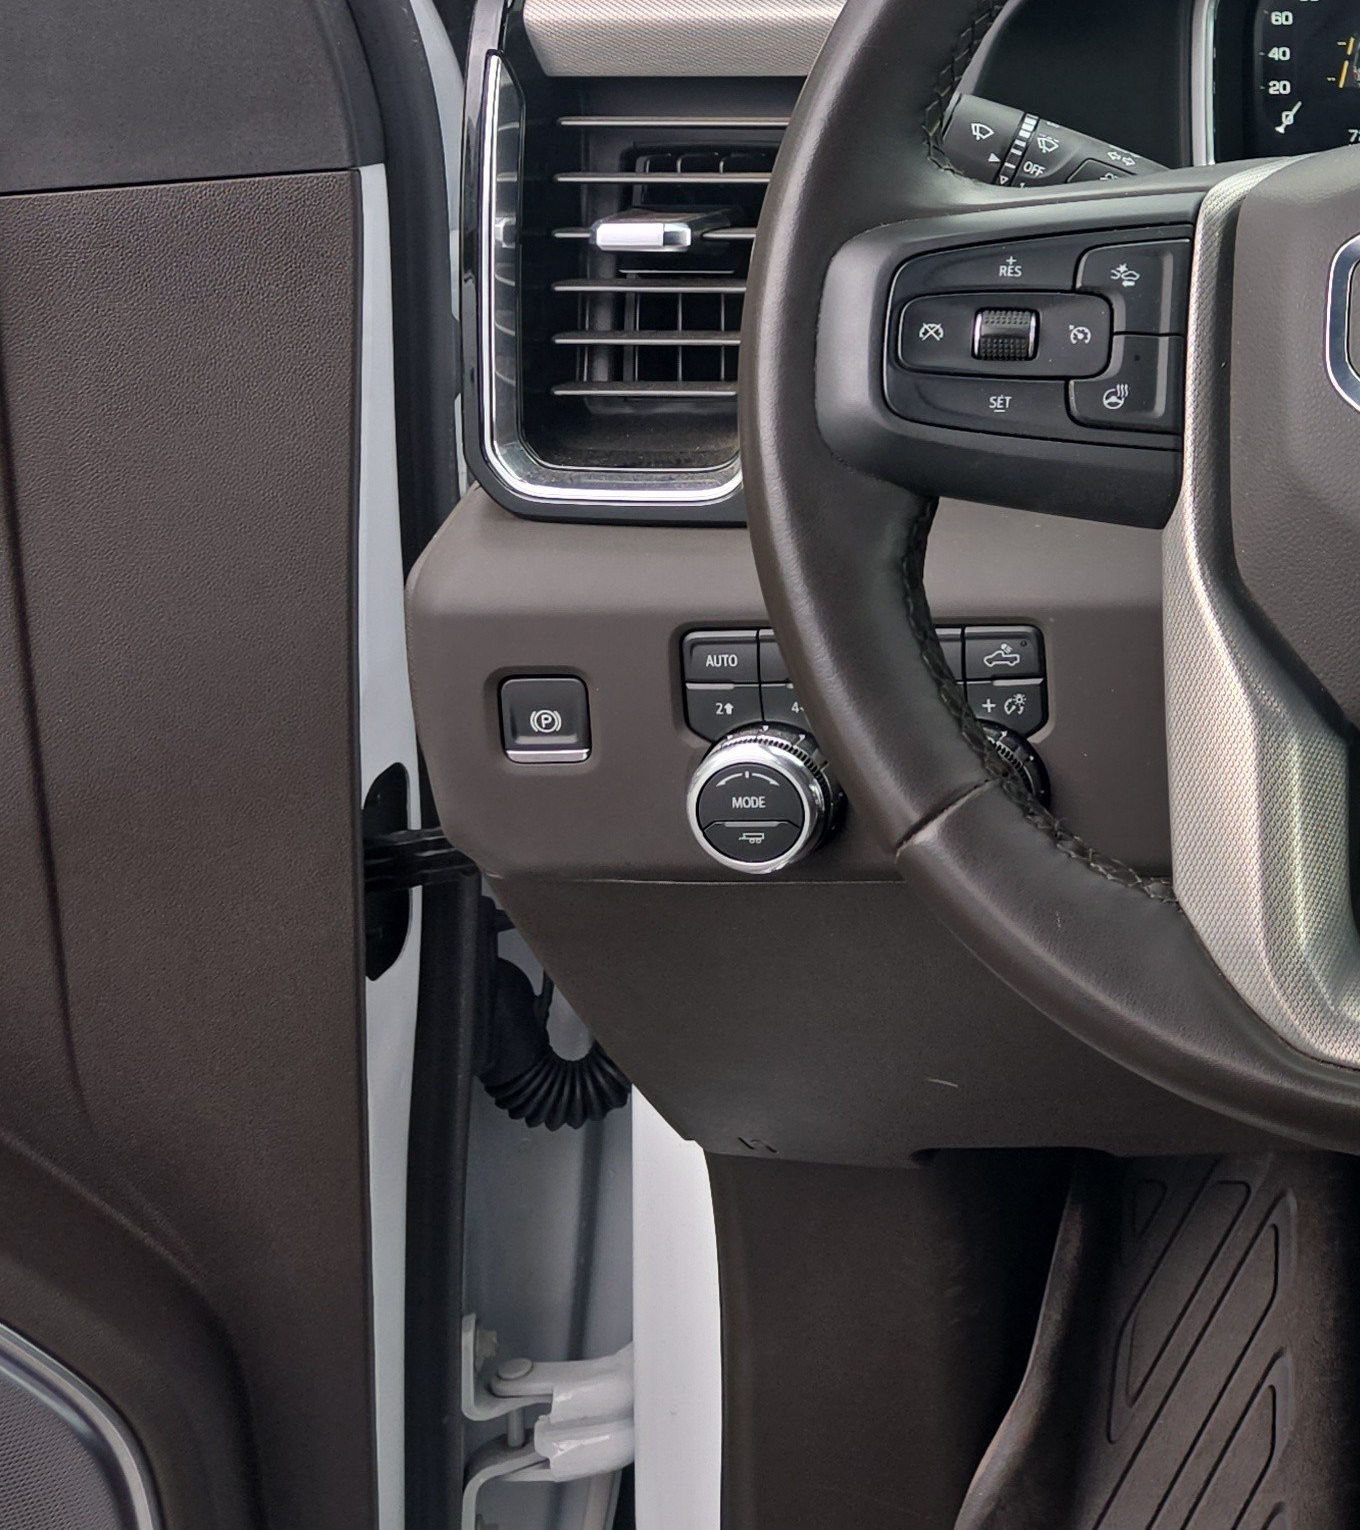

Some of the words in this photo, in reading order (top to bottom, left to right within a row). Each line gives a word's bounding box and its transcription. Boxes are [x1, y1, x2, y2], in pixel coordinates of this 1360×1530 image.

[1270, 10, 1294, 26] 60
[1267, 46, 1291, 62] 40
[1268, 80, 1291, 95] 20
[1023, 161, 1046, 176] OFF
[999, 265, 1022, 277] RES
[989, 396, 1012, 409] SET
[705, 654, 738, 667] AUTO
[731, 796, 766, 810] MODE
